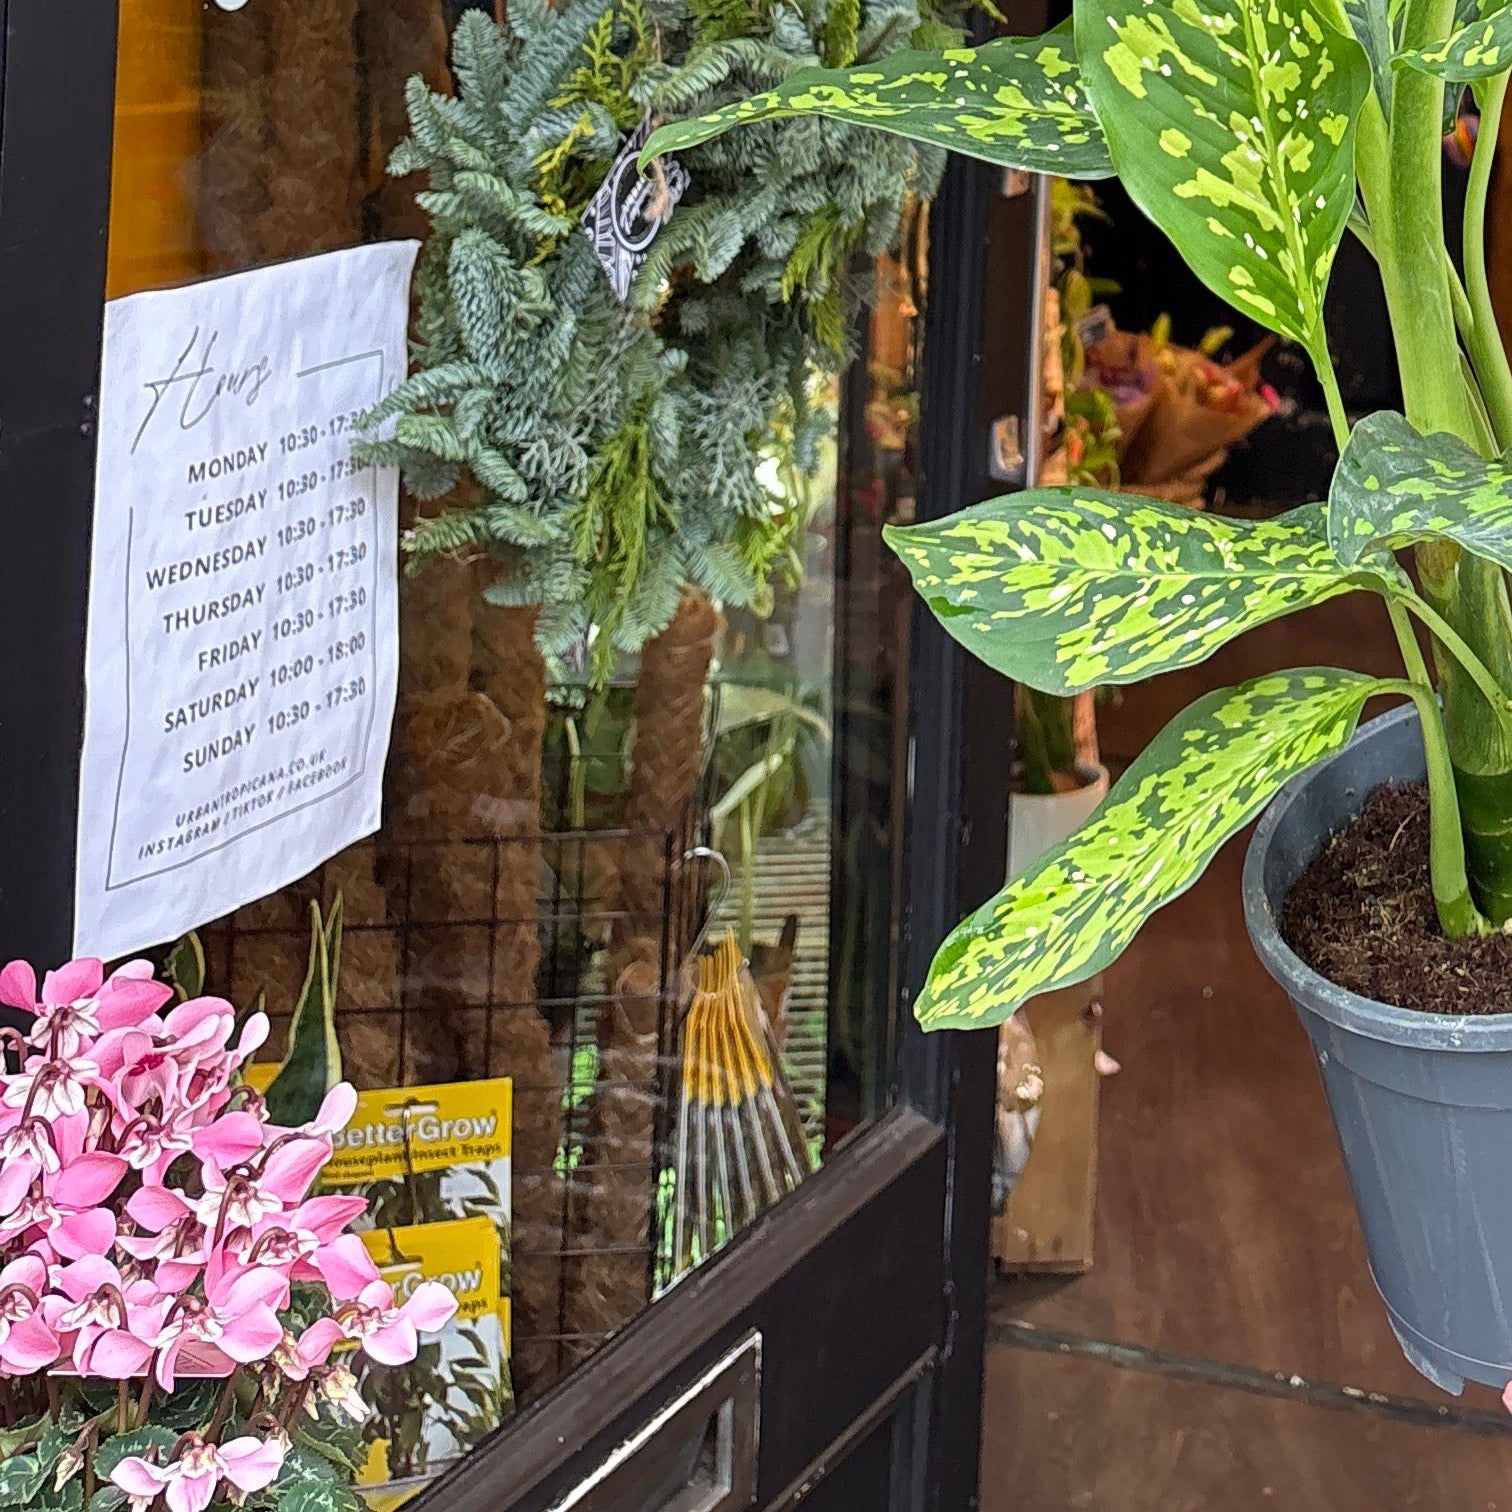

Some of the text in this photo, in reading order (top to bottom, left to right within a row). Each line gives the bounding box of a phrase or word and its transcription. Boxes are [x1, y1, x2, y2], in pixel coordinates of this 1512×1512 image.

[131, 325, 272, 455] Hours
[185, 489, 267, 531] TUESDAY
[277, 471, 318, 501] 10:30
[188, 442, 267, 484] MONDAY
[280, 425, 318, 455] 10:30
[146, 536, 267, 591] WEDNESDAY
[277, 516, 316, 549] 10:30
[327, 496, 366, 527] 17:30
[163, 583, 266, 634] THURSDAY
[276, 562, 314, 595] 10:30
[327, 541, 367, 571] 17:30
[198, 630, 263, 671] FRIDAY
[272, 609, 314, 641] 10:30
[328, 587, 367, 619] 17:30
[164, 677, 260, 733] SATURDAY
[270, 654, 313, 686] 10:00
[327, 631, 366, 664] 18:00
[183, 723, 256, 773] SUNDAY
[267, 701, 310, 735] 10:30
[325, 676, 366, 709] 17:30
[138, 816, 220, 860] INSTAGRAM
[231, 792, 274, 821] TIKTOK
[287, 758, 348, 794] FACEBOOK
